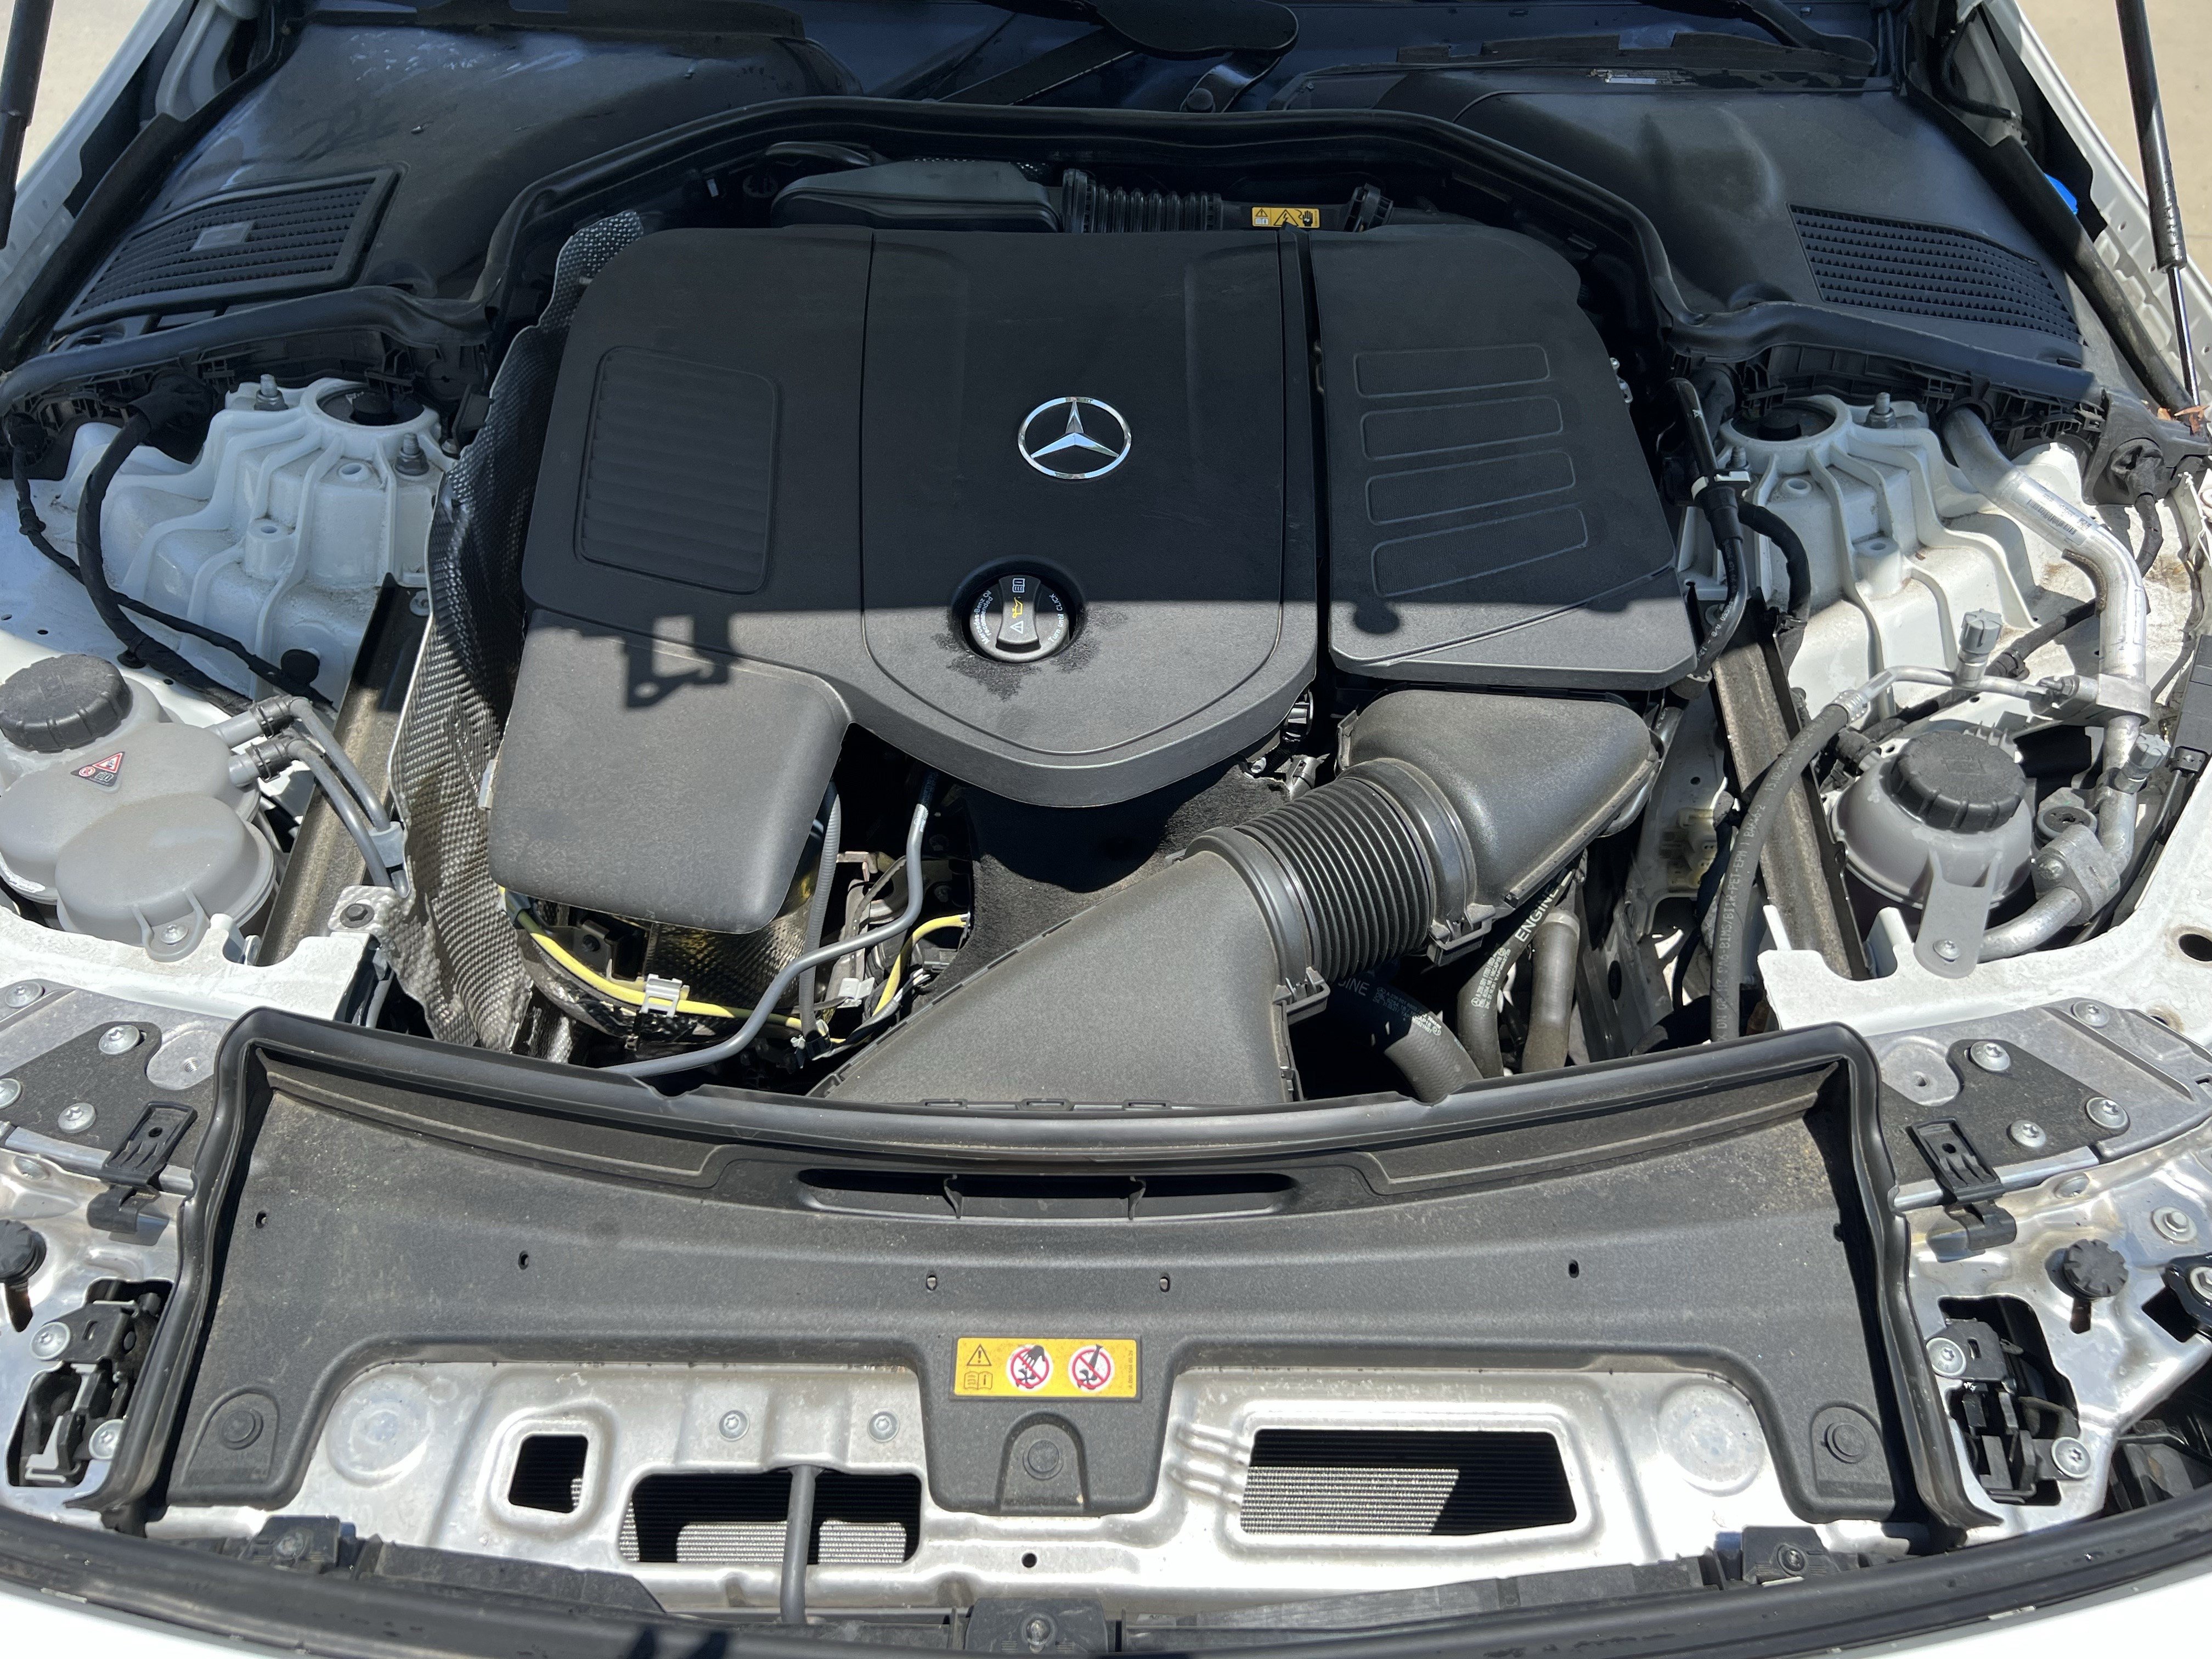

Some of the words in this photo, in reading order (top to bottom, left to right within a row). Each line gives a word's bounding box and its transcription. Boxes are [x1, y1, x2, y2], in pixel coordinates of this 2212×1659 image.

[973, 598, 990, 645] Mercedes-Benz
[983, 590, 992, 598] Oil
[980, 596, 994, 636] recommended
[1049, 593, 1063, 611] CLICK
[1047, 629, 1061, 642] Turn
[1515, 885, 1559, 942] ENGINE
